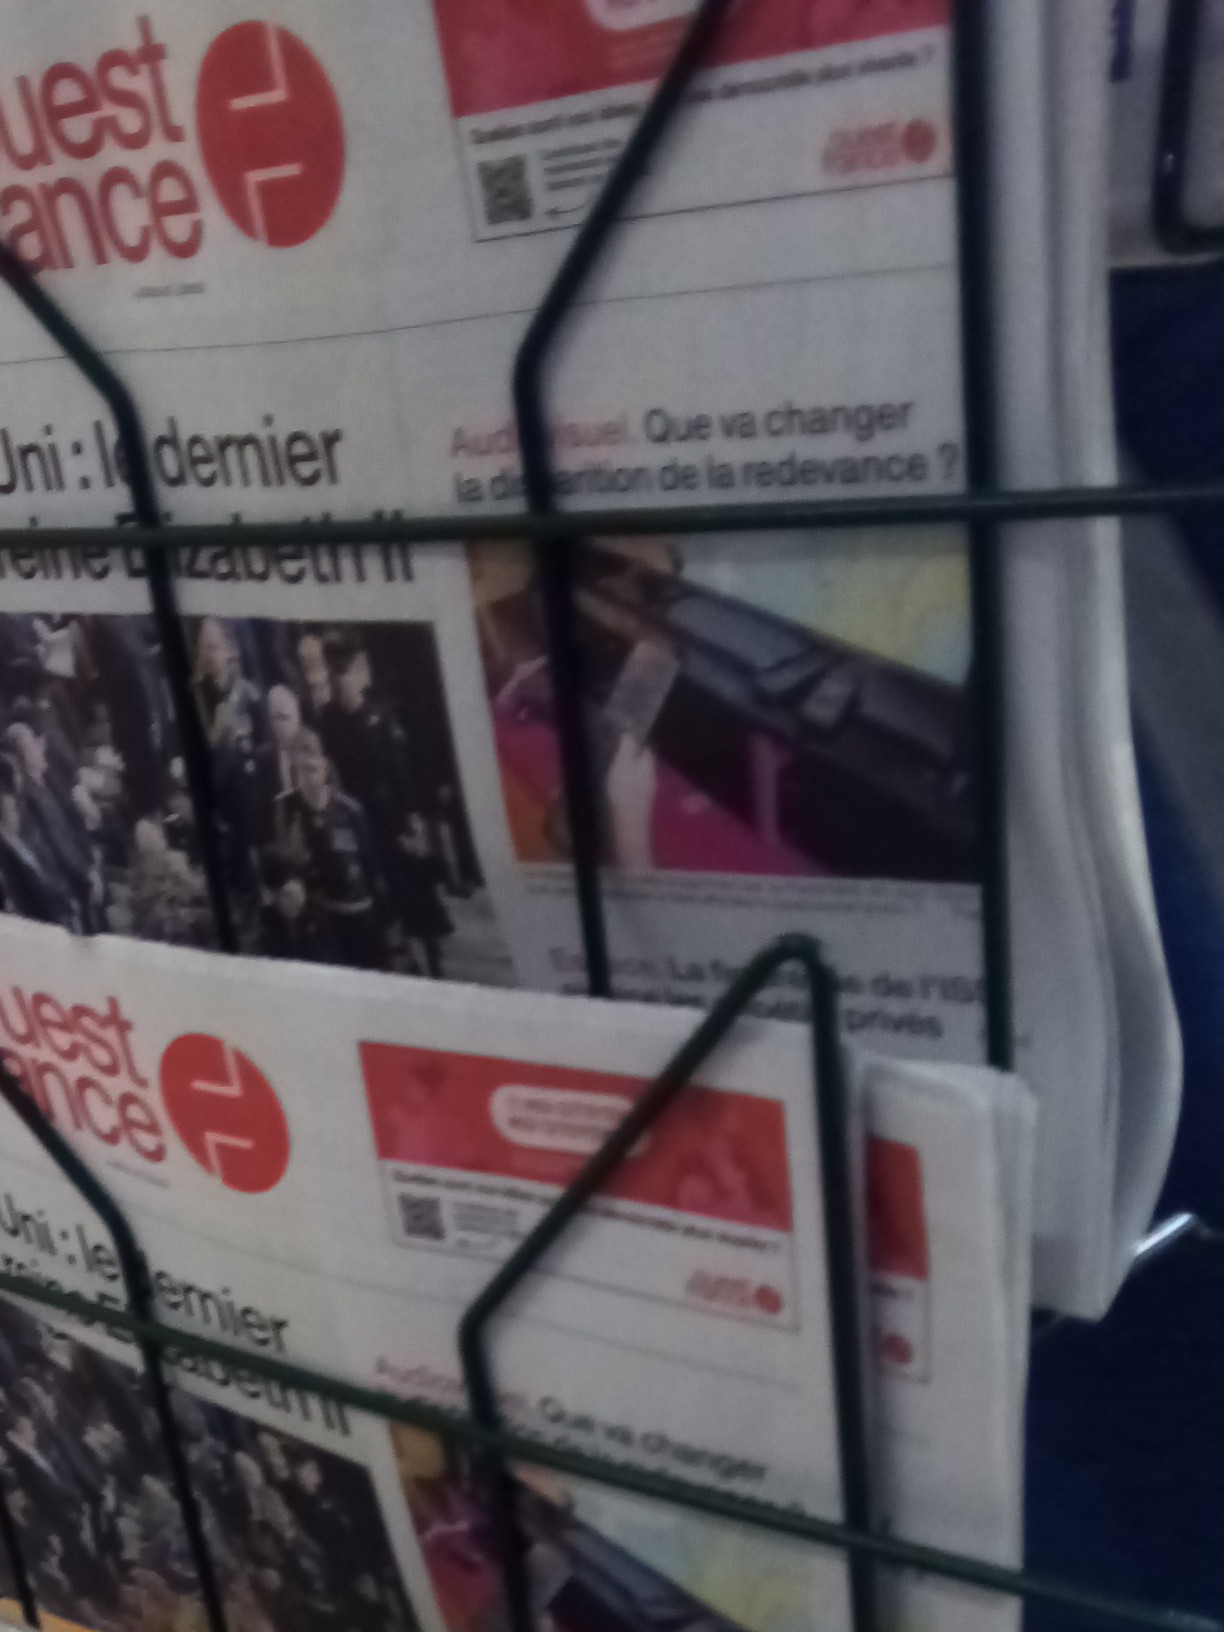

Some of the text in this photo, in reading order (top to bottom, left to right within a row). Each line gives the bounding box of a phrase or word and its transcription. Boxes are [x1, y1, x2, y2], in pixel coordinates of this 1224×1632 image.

[642, 406, 713, 445] Que
[720, 410, 758, 441] va
[764, 399, 915, 443] changer
[152, 415, 344, 488] dernier
[742, 449, 930, 488] redevance
